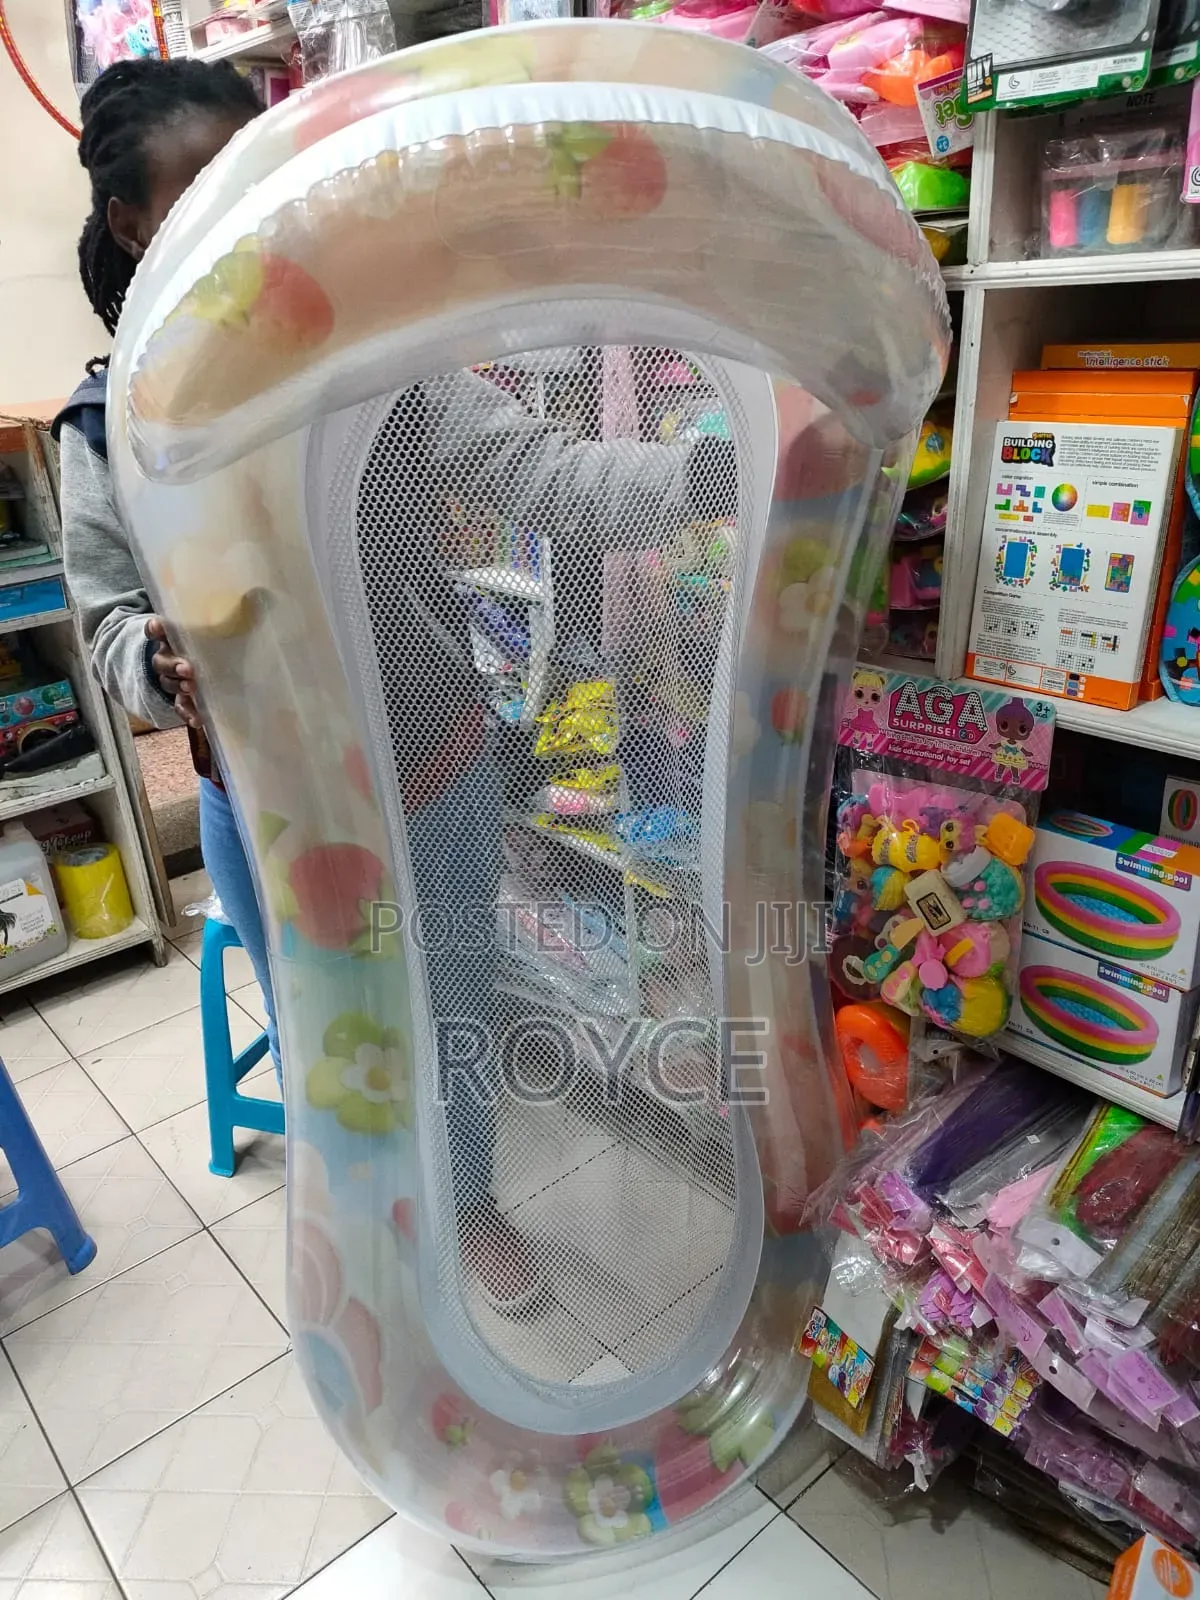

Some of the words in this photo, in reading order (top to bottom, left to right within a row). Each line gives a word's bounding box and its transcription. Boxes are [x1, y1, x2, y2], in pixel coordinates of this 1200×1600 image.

[1127, 92, 1156, 108] NOTE
[1086, 356, 1142, 368] Intelligence
[1144, 356, 1169, 368] stick
[1003, 437, 1053, 449] BUILDING
[1002, 446, 1053, 466] BLOCK
[1035, 702, 1051, 713] 3+
[892, 718, 956, 737] SURPRISE!
[888, 744, 902, 752] kids
[903, 747, 944, 761] educational
[946, 755, 958, 765] toy
